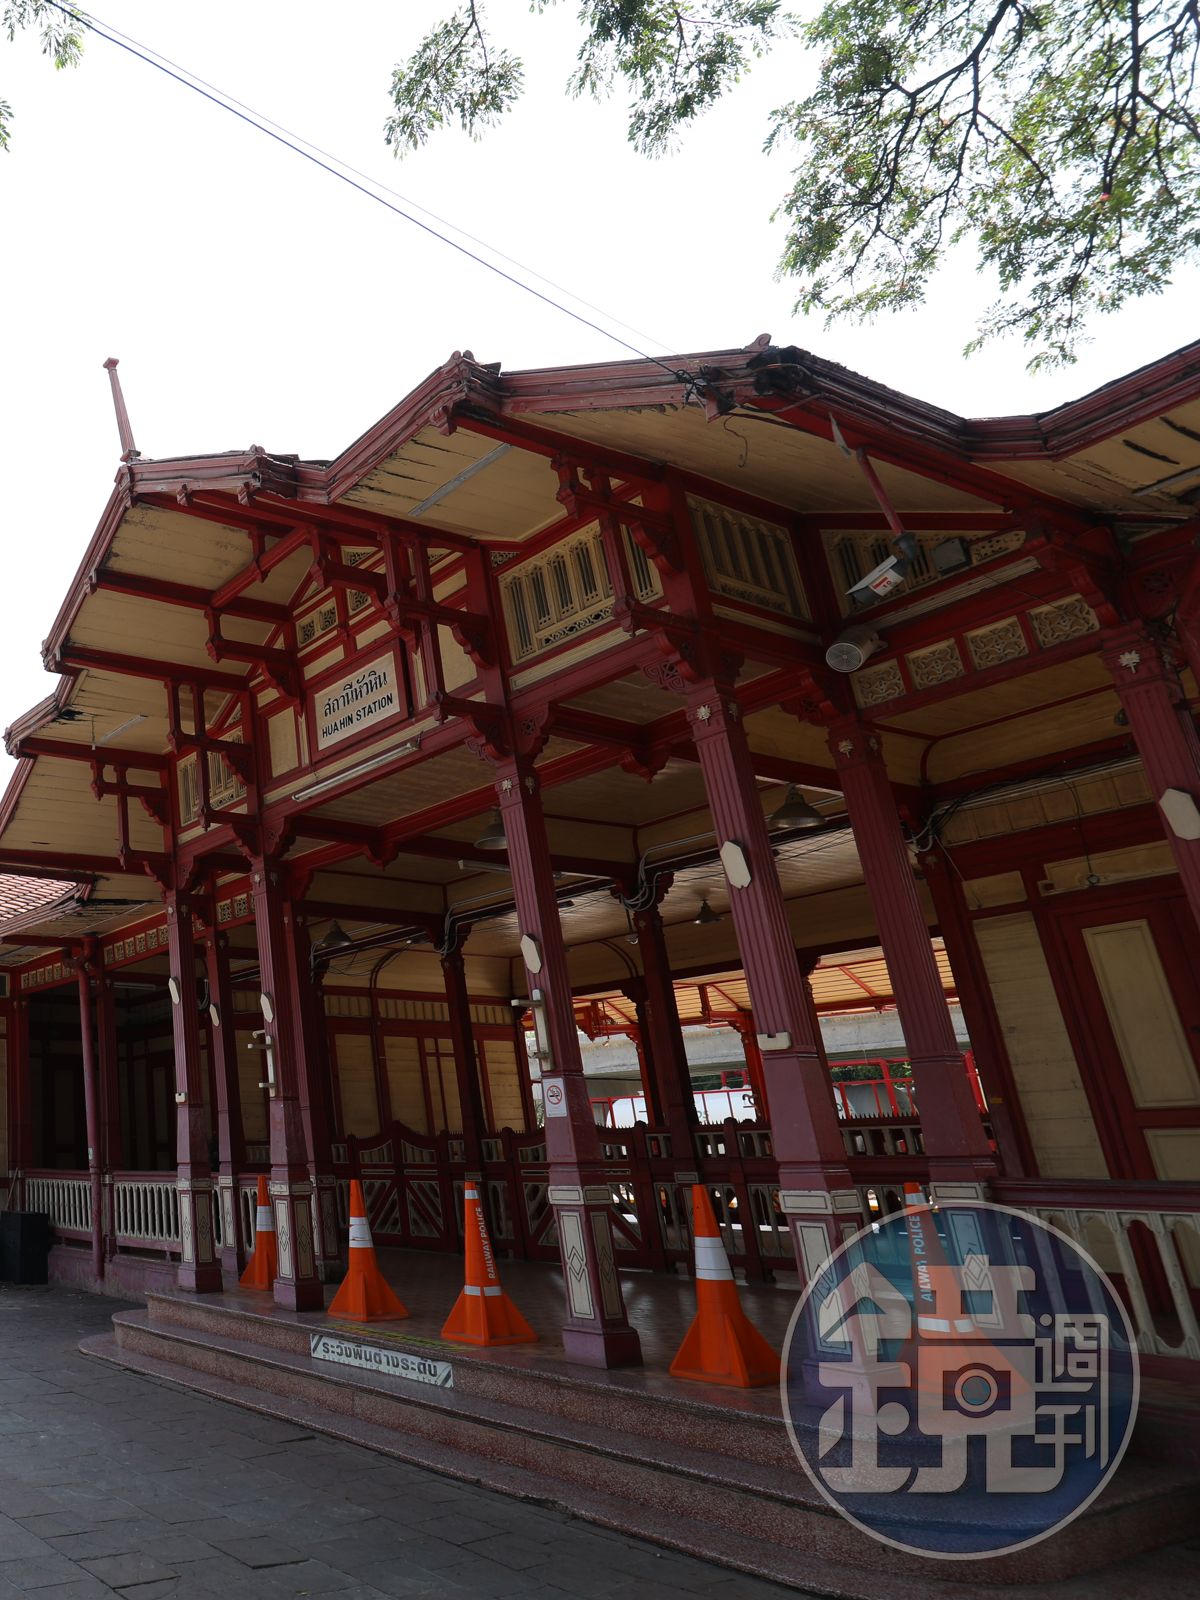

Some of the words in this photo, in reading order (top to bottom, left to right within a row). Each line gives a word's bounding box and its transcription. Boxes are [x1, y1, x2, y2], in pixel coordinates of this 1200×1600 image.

[323, 670, 388, 717] สถานีหัวหิน
[355, 693, 393, 721] STATION
[475, 1207, 488, 1238] POLICE
[908, 1215, 926, 1255] POLICE
[480, 1239, 497, 1279] RAILWAY
